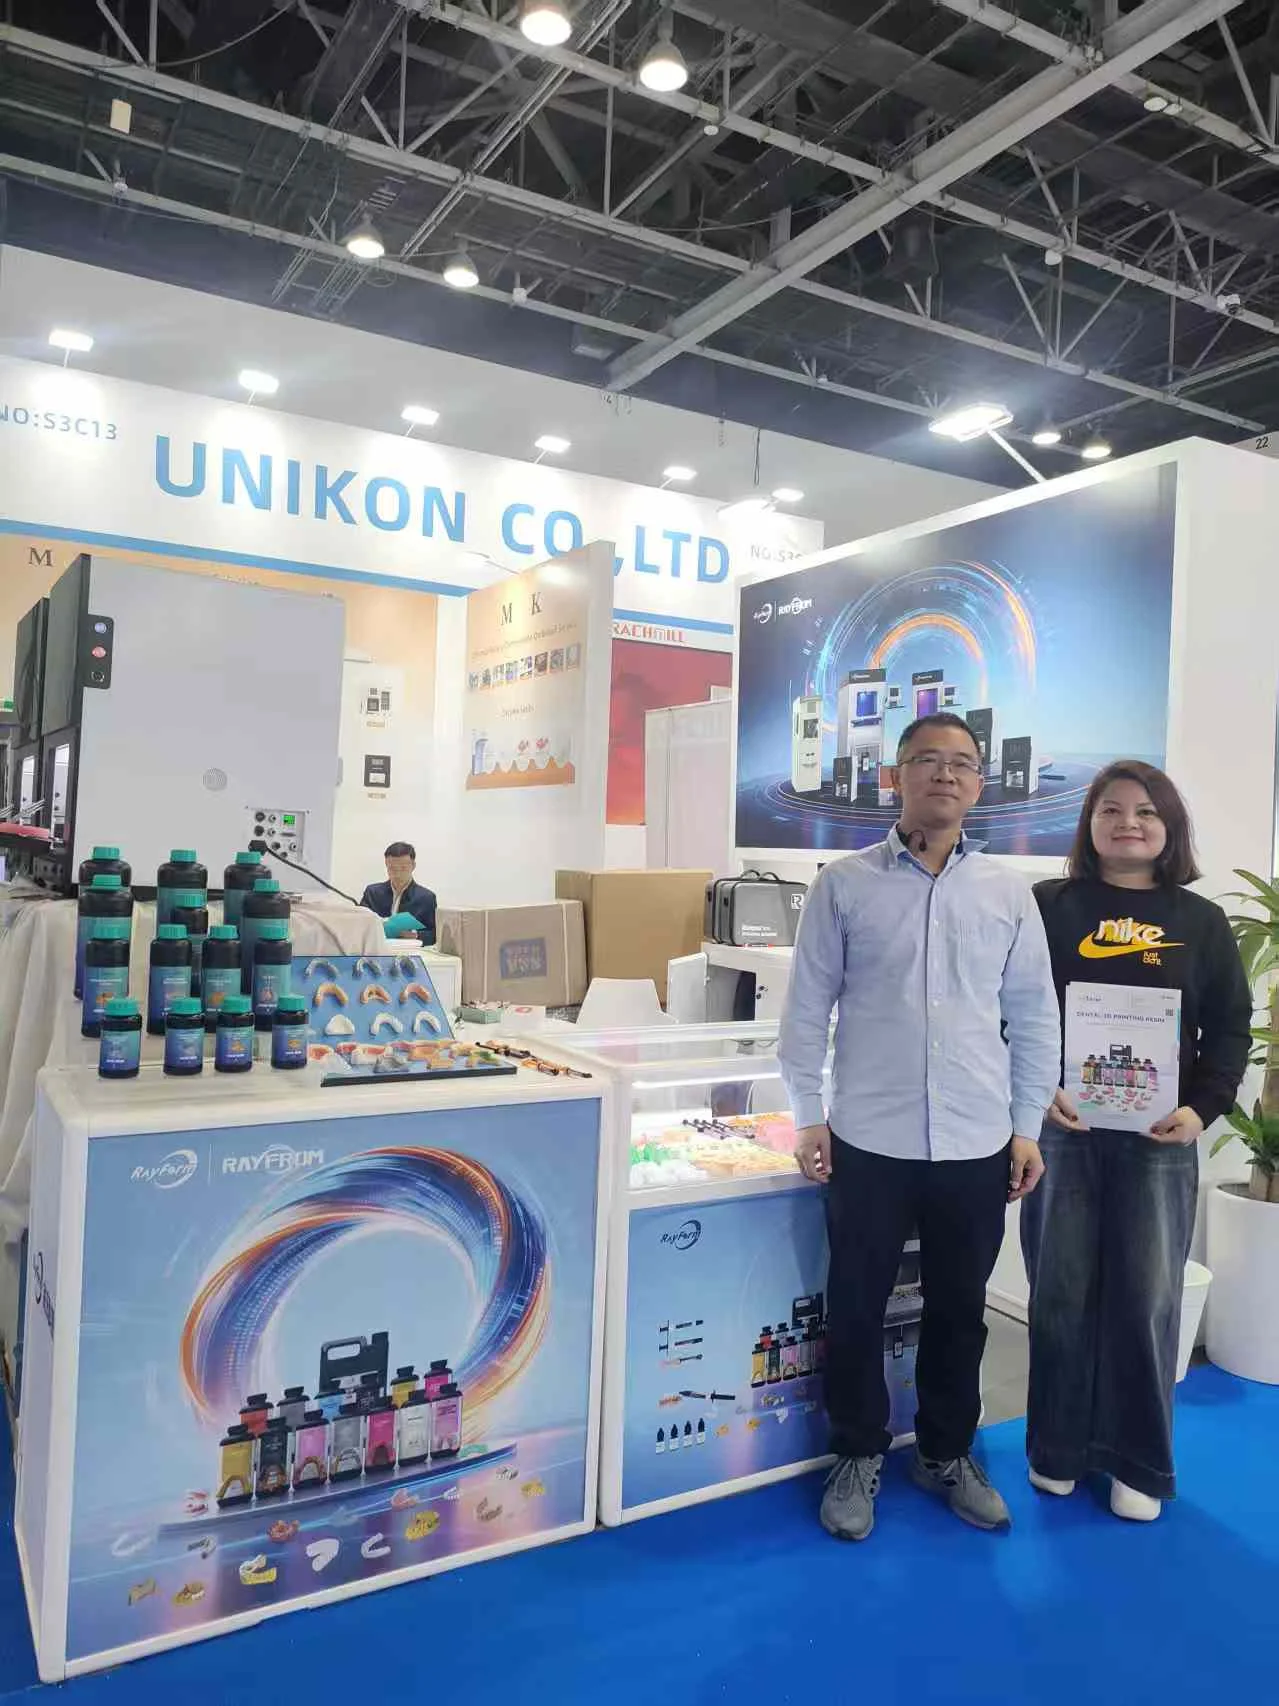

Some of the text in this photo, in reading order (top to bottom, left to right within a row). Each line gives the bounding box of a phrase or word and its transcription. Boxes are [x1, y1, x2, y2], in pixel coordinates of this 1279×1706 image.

[0, 404, 117, 440] NO:S3C13
[1255, 436, 1269, 450] 22
[155, 434, 466, 543] UNIKON
[28, 546, 53, 567] M
[500, 591, 543, 627] M K
